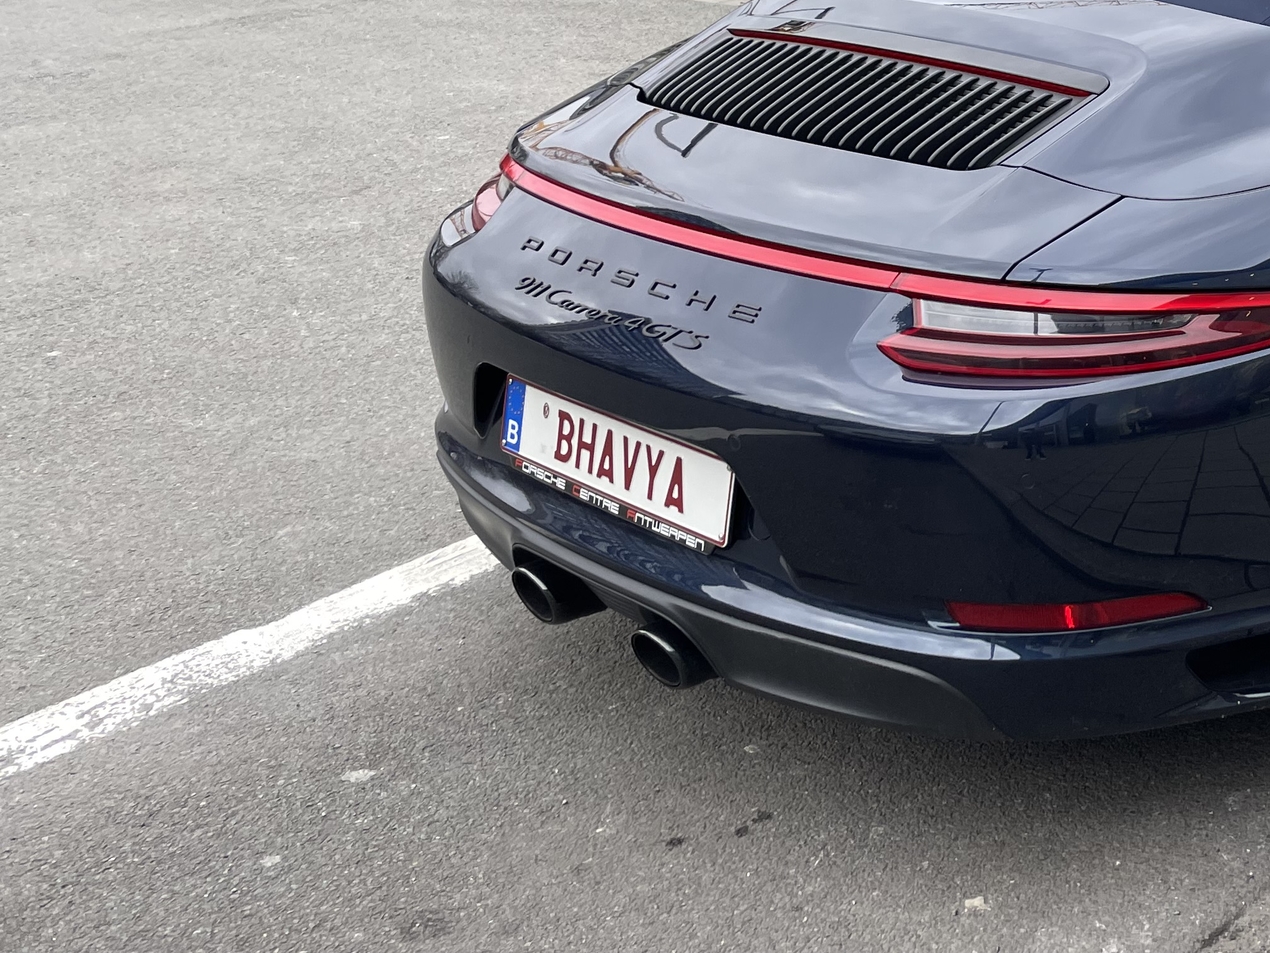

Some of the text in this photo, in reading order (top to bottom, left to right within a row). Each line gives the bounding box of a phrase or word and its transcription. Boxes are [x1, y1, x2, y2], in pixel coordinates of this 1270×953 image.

[515, 276, 551, 298] 911
[546, 290, 622, 326] Carrera
[642, 323, 709, 350] GTS
[520, 235, 762, 324] PORSCHE
[507, 419, 519, 445] B
[554, 409, 684, 514] BHAVYA
[515, 459, 705, 552] PORSCHE CENTRE ANTWERPEN
